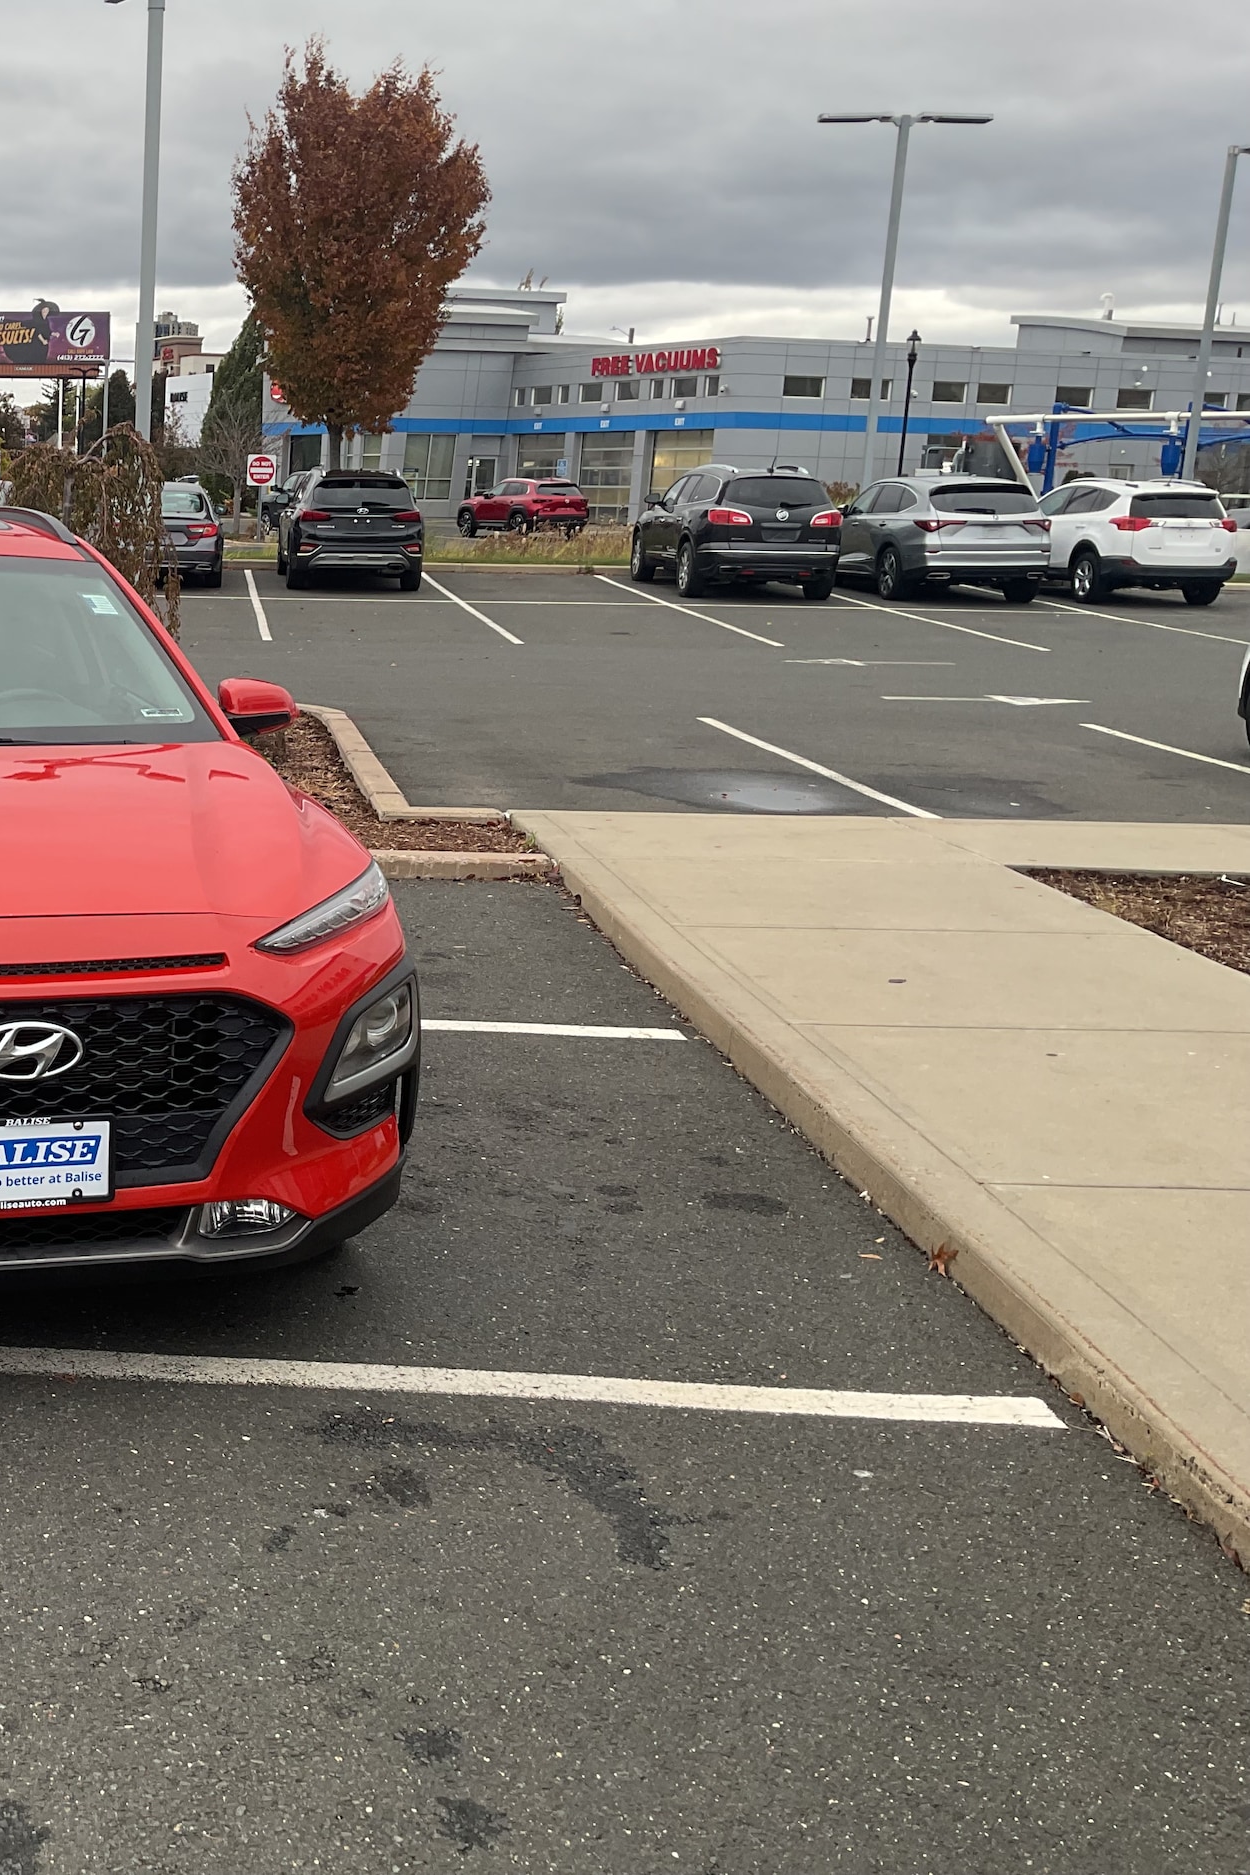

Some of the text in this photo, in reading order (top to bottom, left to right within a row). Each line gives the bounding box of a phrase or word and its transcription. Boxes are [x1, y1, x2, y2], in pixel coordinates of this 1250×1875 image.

[591, 347, 721, 377] FREE VACUUMS
[5, 1116, 51, 1127] BALISE
[6, 1175, 45, 1187] better
[48, 1173, 61, 1184] at
[65, 1171, 102, 1183] Balise
